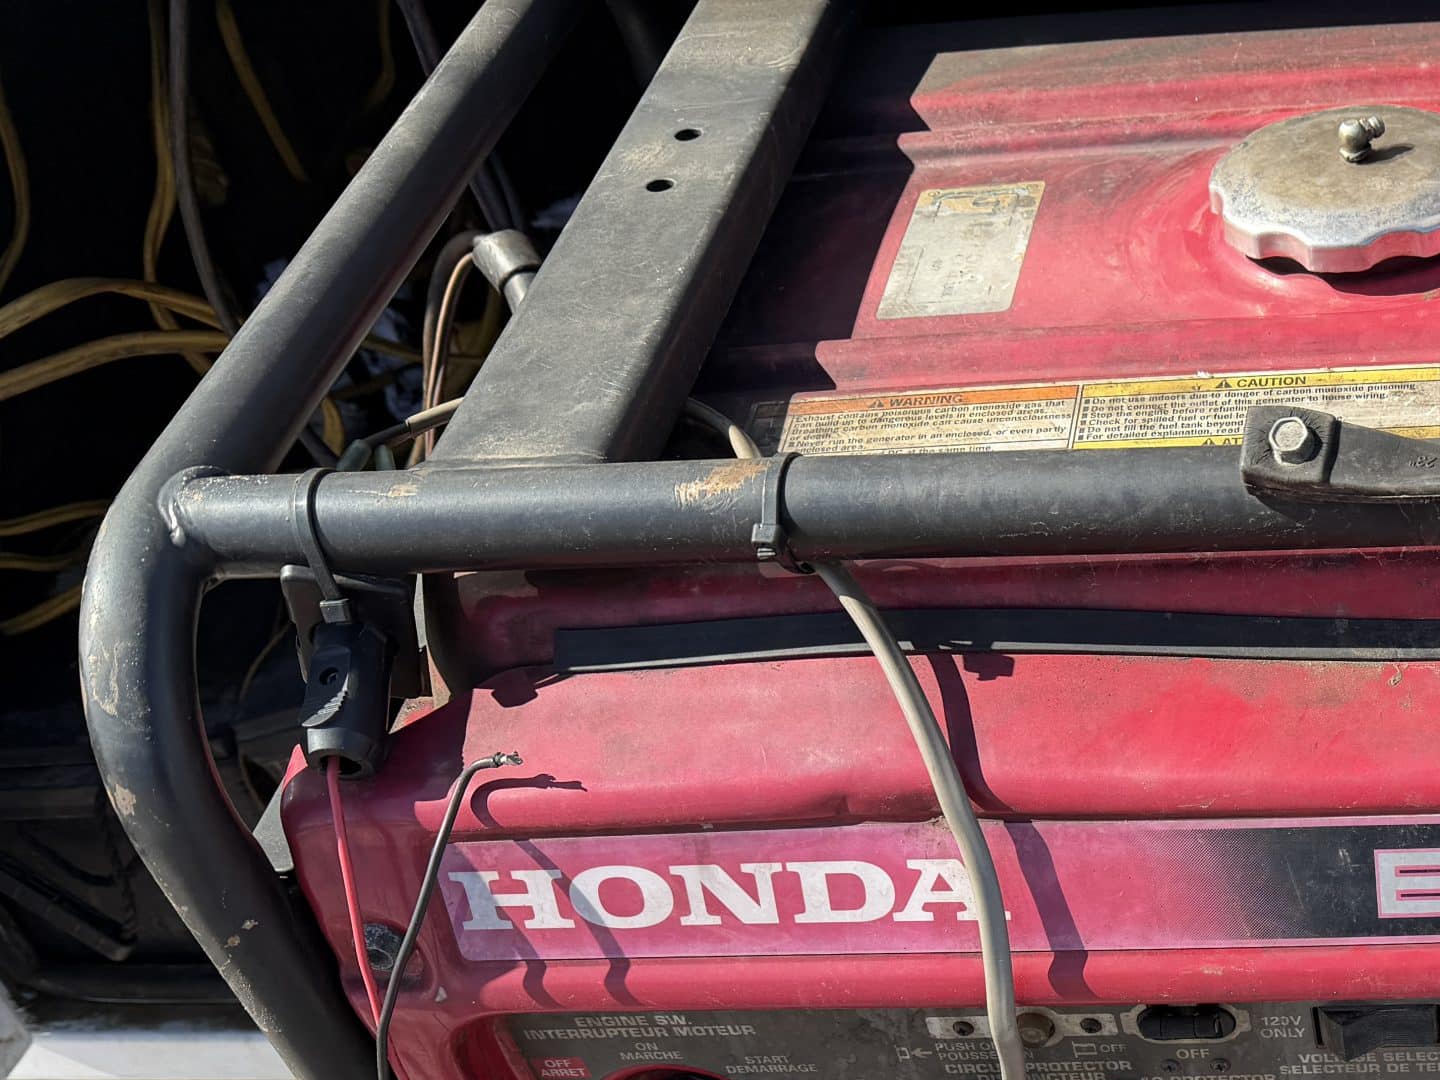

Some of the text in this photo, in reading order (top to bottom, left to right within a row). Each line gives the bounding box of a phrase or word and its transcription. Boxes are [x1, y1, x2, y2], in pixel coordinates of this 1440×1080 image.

[1236, 375, 1307, 389] CAUTION
[1224, 389, 1259, 400] danger
[1263, 388, 1274, 396] of
[1276, 387, 1312, 396] carbon
[889, 394, 964, 408] WARNING
[935, 405, 969, 414] carbon
[1024, 401, 1042, 410] gas
[1045, 400, 1065, 408] that
[1127, 402, 1168, 411] connect
[1170, 401, 1186, 409] the
[1234, 398, 1252, 406] this
[1255, 396, 1305, 406] generator
[1322, 393, 1352, 401] house
[969, 409, 1014, 419] enclosed
[1088, 418, 1120, 427] Check
[1124, 416, 1138, 425] for
[1142, 415, 1174, 425] spilled
[1177, 413, 1197, 422] fuel
[1199, 413, 1210, 421] or
[1213, 411, 1232, 421] fuel
[1090, 406, 1205, 420] Stop the engine before
[843, 423, 878, 432] carbon
[954, 418, 984, 426] cause
[1087, 418, 1244, 434] Do not fill the fuel tank beyond
[796, 440, 825, 448] Never
[867, 434, 915, 444] generator
[1010, 427, 1034, 435] even
[1036, 425, 1067, 435] partly
[1086, 433, 1104, 441] For
[1106, 431, 1148, 440] detailed
[448, 858, 1012, 930] HONDA
[574, 1014, 692, 1028] ENGINE SW.
[1261, 1015, 1303, 1027] 120V
[524, 1024, 757, 1041] INTERRUPTEUR MOTEUR
[1260, 1027, 1306, 1040] ONLY
[634, 1041, 659, 1052] ON
[935, 1041, 976, 1052] PUSH
[1101, 1043, 1129, 1053] OFF
[619, 1050, 684, 1062] MARCHE
[744, 1055, 791, 1066] START
[1175, 1048, 1210, 1060] OFF
[1298, 1052, 1378, 1065] VOLGE
[543, 1059, 572, 1069] OFF
[725, 1063, 818, 1075] DEMARRAGE
[944, 1060, 1133, 1075] CIRCU PROTECTOR
[1279, 1062, 1381, 1075] SELECTEUR
[1386, 1062, 1409, 1073] DE
[541, 1067, 586, 1078] ARRET
